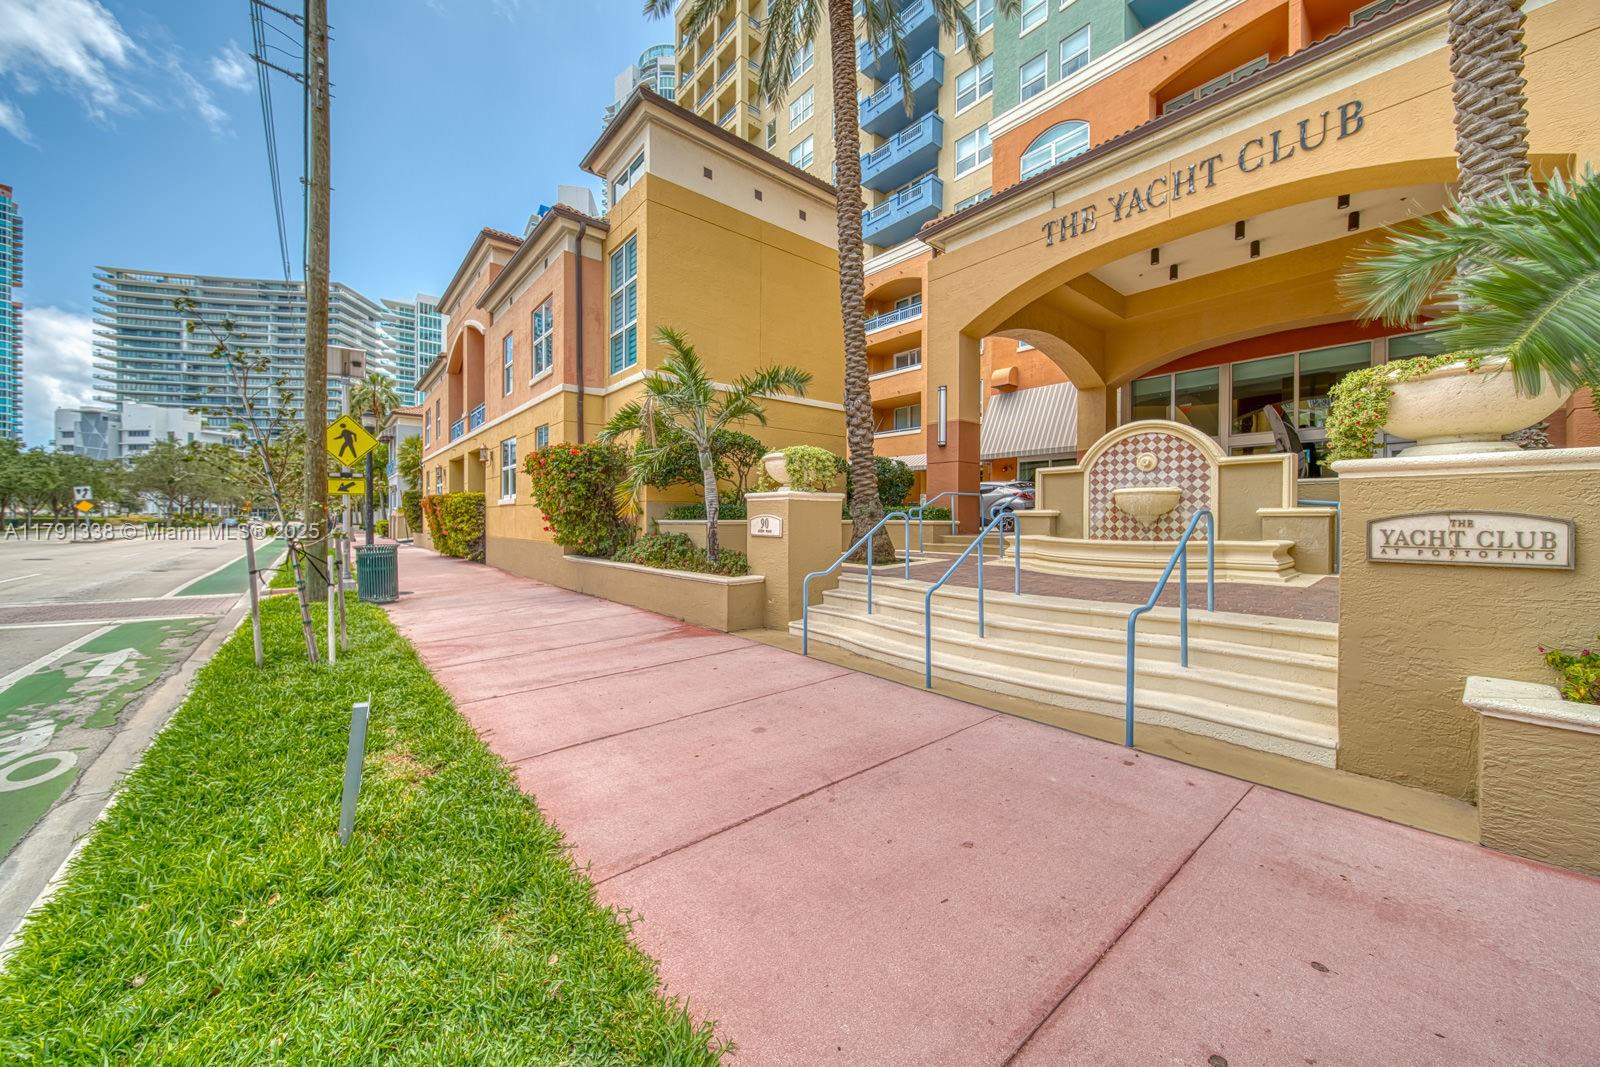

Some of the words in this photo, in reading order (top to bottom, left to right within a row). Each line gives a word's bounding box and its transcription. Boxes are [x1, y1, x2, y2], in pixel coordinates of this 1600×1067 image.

[1042, 204, 1097, 247] THE
[1108, 153, 1223, 222] YACHT
[1238, 99, 1365, 174] CLUB
[760, 518, 769, 528] 90
[1450, 519, 1474, 528] THE
[1380, 529, 1466, 548] YACHT
[1476, 530, 1557, 550] CLUB
[1418, 550, 1556, 561] PORTOFINO
